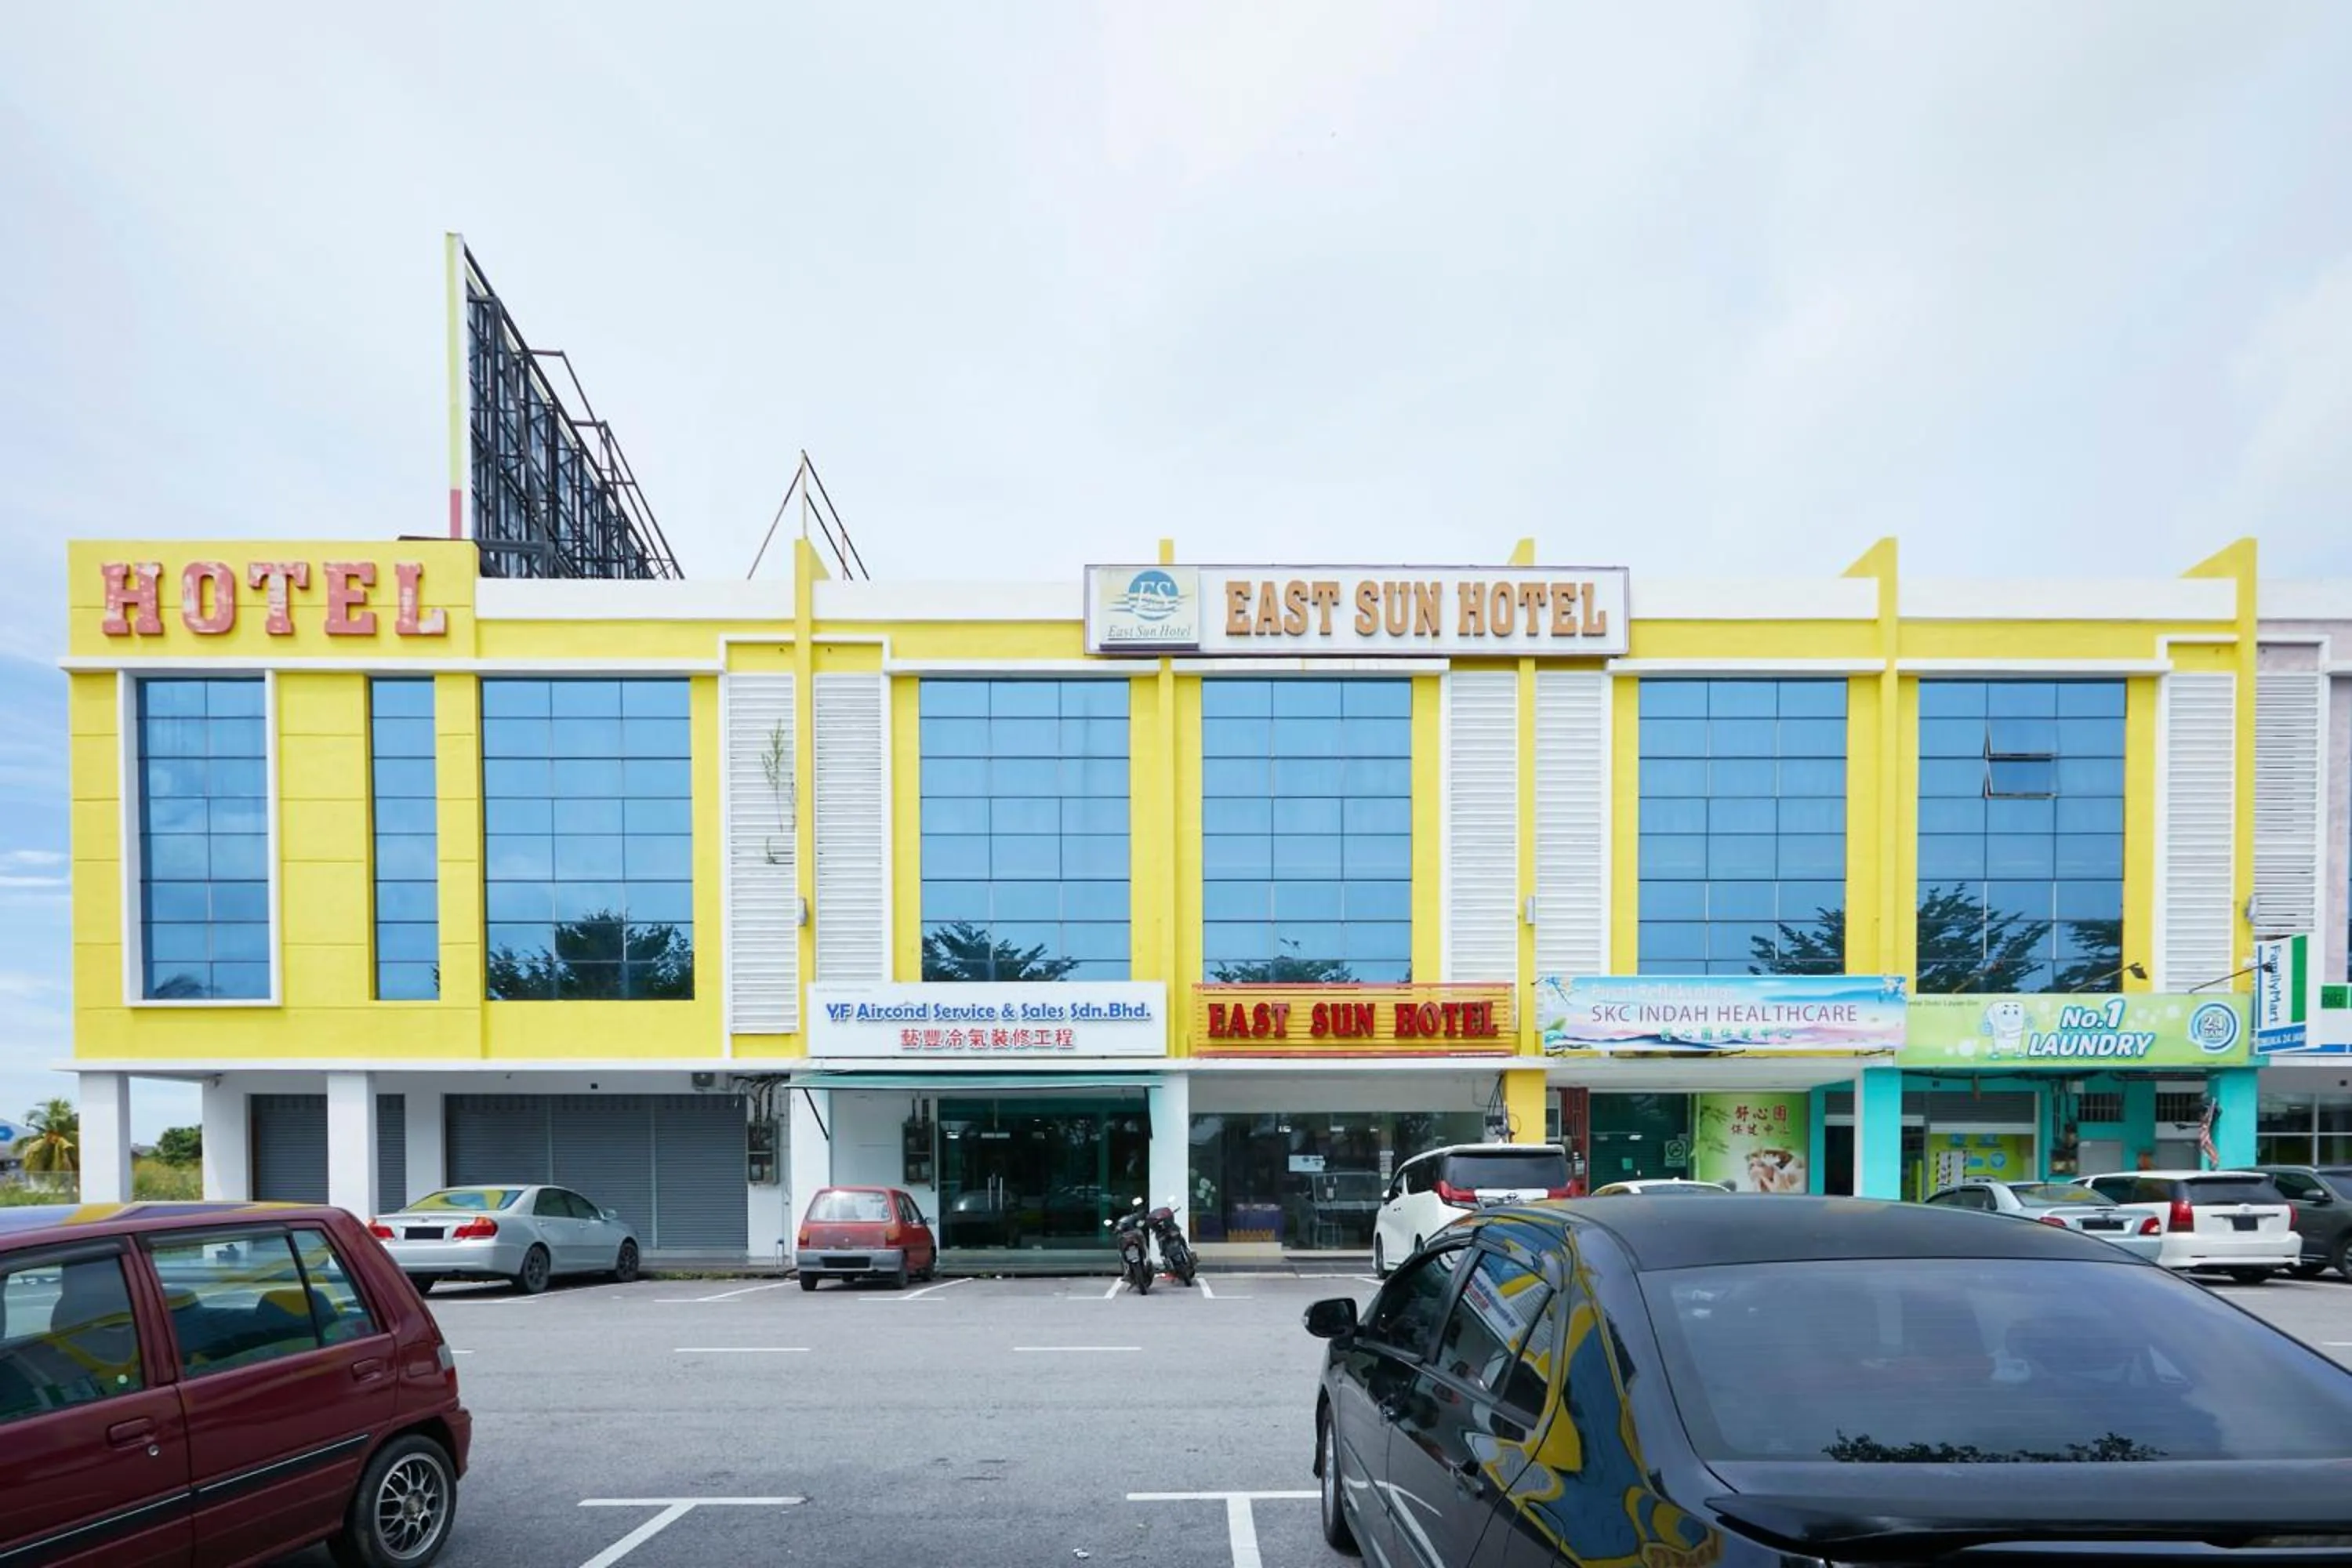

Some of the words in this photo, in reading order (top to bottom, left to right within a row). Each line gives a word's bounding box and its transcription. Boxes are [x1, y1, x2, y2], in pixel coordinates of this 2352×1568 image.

[101, 561, 448, 636] HOTEL
[1225, 579, 1340, 637] EAST
[1354, 579, 1443, 637] SUN
[1457, 581, 1607, 637] HOTEL
[1107, 625, 1134, 637] East
[1136, 625, 1157, 637] Sun
[1160, 624, 1192, 637] Hotel
[826, 1003, 851, 1019] YF
[857, 1003, 927, 1020] Aircond
[933, 1003, 996, 1020] Service
[1001, 1003, 1014, 1019] &
[1021, 1002, 1065, 1020] Sales
[1207, 1002, 1290, 1039] EAST
[1309, 1000, 1376, 1039] SUN
[1393, 1000, 1499, 1039] HOTEL
[1592, 1004, 1631, 1022] SKC
[1639, 1004, 1708, 1022] INDAH
[1717, 1004, 1857, 1022] HEALTHCARE
[2060, 999, 2125, 1029] No.1
[901, 1028, 1074, 1048] 藝豐冷氣裝修工程
[2027, 1033, 2154, 1058] LAUNDRY
